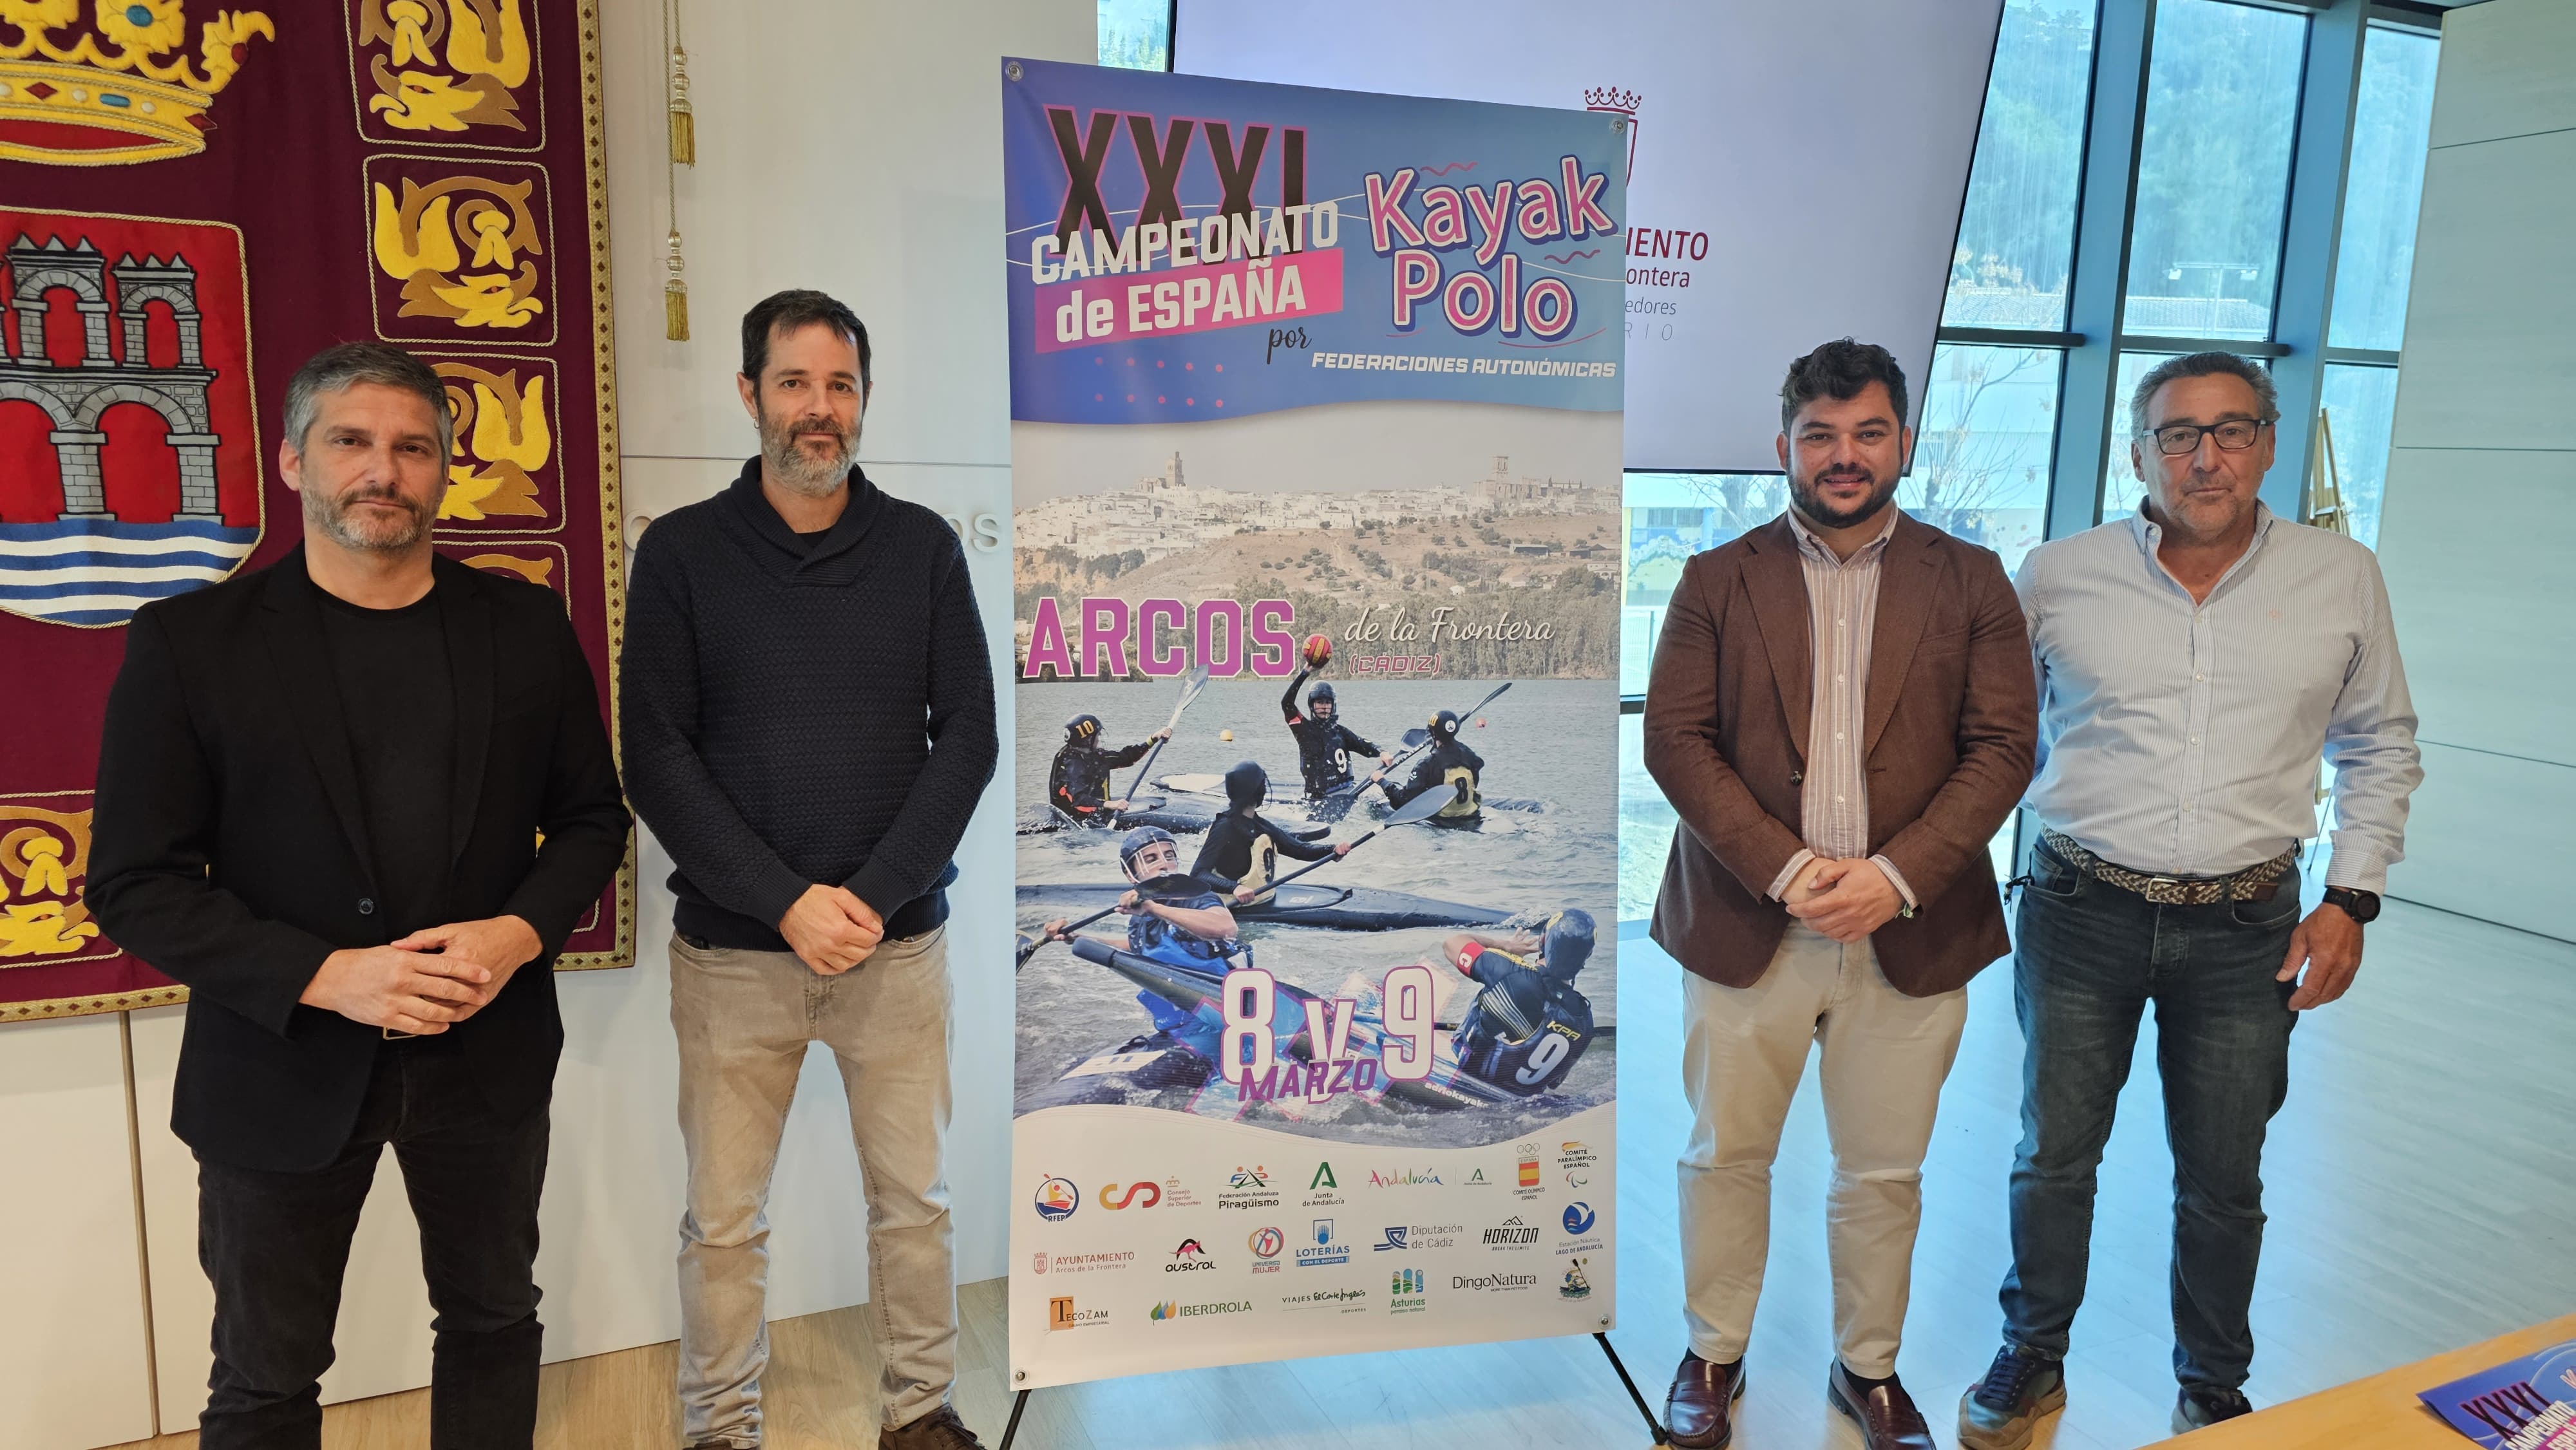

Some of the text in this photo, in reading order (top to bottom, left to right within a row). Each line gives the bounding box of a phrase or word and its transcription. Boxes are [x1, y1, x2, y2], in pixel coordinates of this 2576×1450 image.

[1042, 103, 1307, 265] XXXI
[1364, 155, 1616, 265] Kayak
[1031, 200, 1338, 285] CAMPEONATO
[1056, 256, 1307, 343] de ESPAÑA
[1393, 249, 1575, 339] Polo
[1267, 326, 1312, 364] por
[1311, 352, 1616, 378] FEDERACIONES AUTONÓMICAS
[1344, 607, 1556, 643] de la Frontera
[1022, 596, 1296, 678] ARCOS
[1349, 652, 1441, 675] (CÁDIZ)
[1075, 720, 1095, 739] 10
[1334, 748, 1347, 773] 9
[1455, 777, 1468, 804] 8
[1220, 968, 1276, 1085] 8
[1381, 965, 1434, 1081] 9
[1547, 1021, 1581, 1040] KPA
[1516, 1034, 1569, 1085] 9
[1238, 1057, 1378, 1102] MARZO
[1557, 1155, 1597, 1163] PARALÍMPICO
[1368, 1167, 1444, 1188] Andalucía
[1218, 1198, 1279, 1209] Piragüismo
[1312, 1198, 1345, 1206] Andalucía
[1048, 1214, 1066, 1223] RFEP
[1412, 1223, 1463, 1237] Diputación
[1482, 1227, 1539, 1244] HORIZON
[1296, 1245, 1350, 1257] LOTERÍAS
[1412, 1238, 1454, 1248] de Cádiz
[1577, 1244, 1603, 1252] ANDALUCÍA
[1056, 1252, 1135, 1265] AYUNTAMIENTO
[1165, 1261, 1217, 1272] austral
[1453, 1274, 1537, 1290] DingoNatura
[1314, 1292, 1321, 1301] El
[1321, 1292, 1340, 1300] Corte
[1390, 1298, 1426, 1308] Asturias
[1180, 1301, 1253, 1317] IBERDROLA
